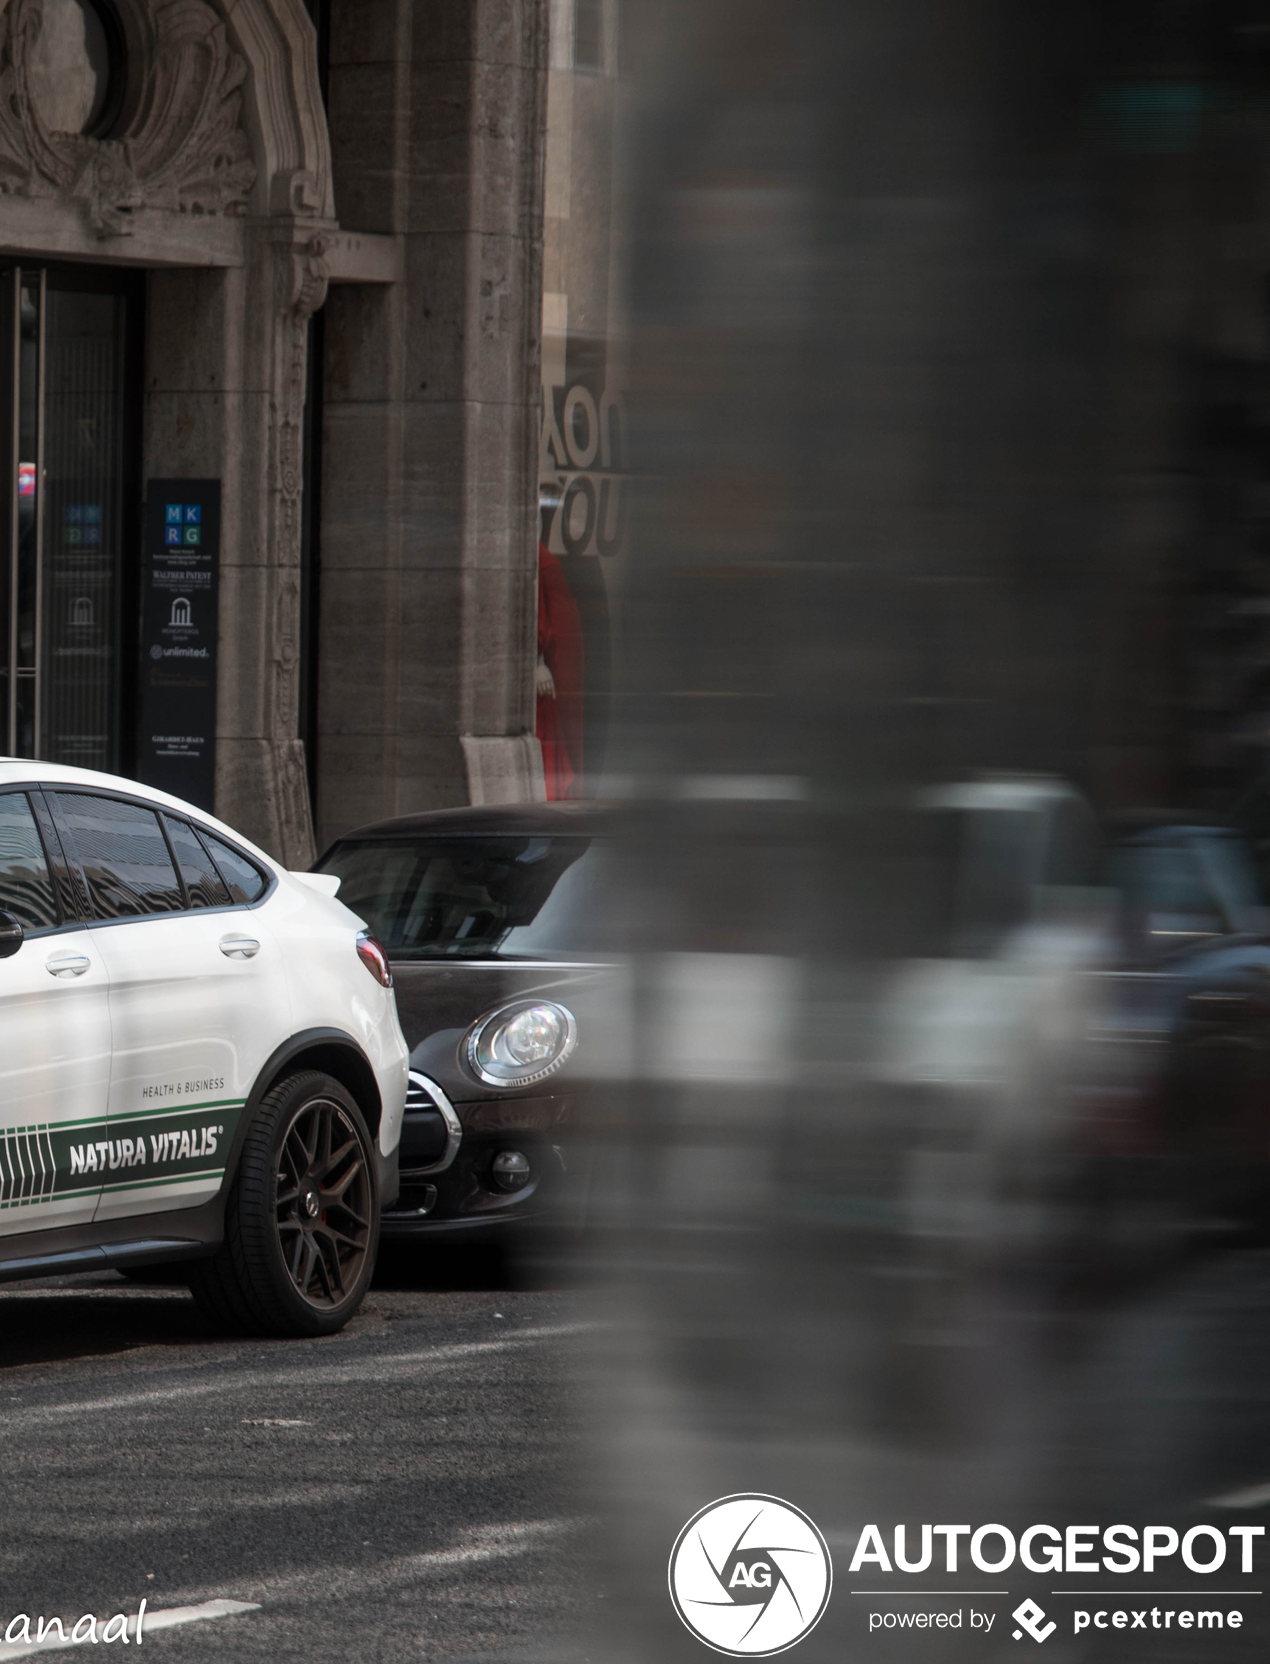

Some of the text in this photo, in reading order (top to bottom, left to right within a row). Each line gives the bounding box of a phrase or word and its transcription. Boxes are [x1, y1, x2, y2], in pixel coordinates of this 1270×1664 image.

[142, 1077, 224, 1098] HEALTH & BUSINESS
[69, 1135, 146, 1176] NATURA
